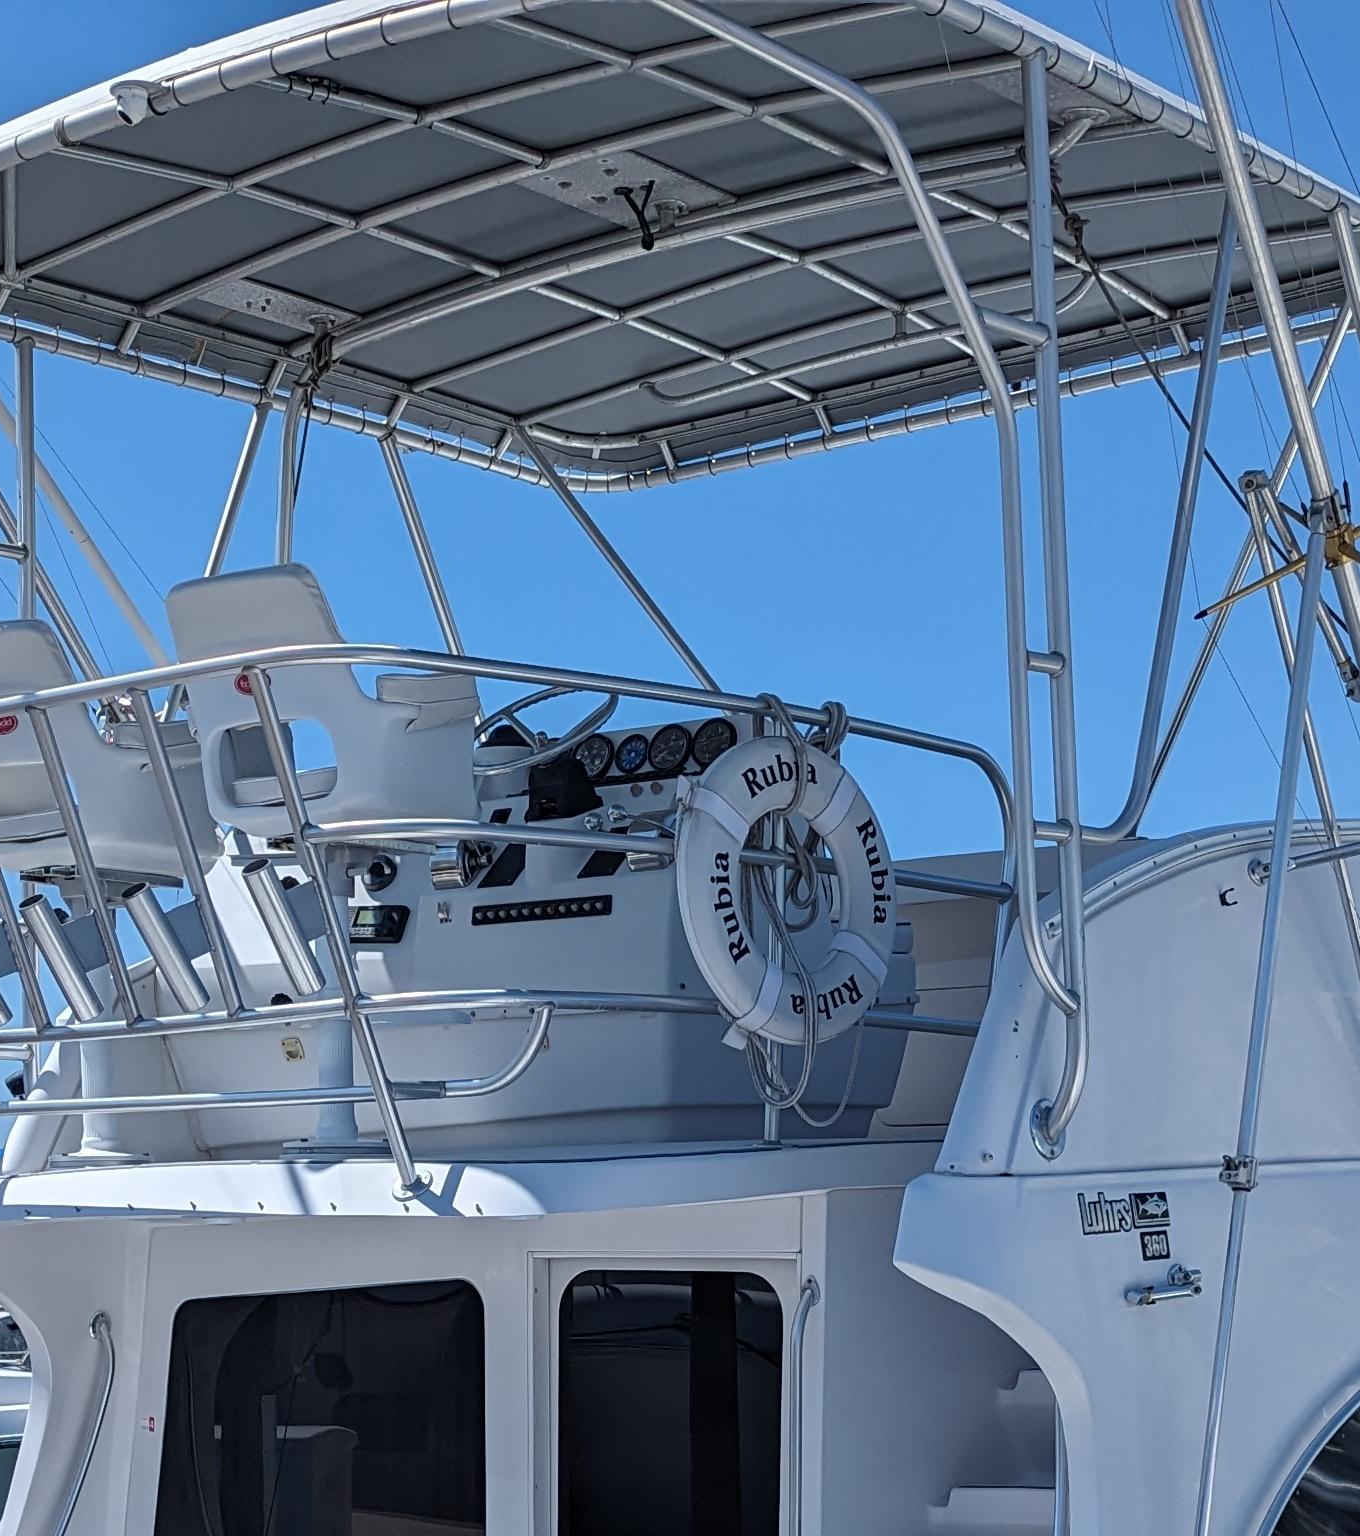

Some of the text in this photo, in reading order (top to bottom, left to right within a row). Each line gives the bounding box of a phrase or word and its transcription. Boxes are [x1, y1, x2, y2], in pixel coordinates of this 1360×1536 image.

[855, 816, 892, 926] Rubia
[710, 851, 751, 965] Rubia
[790, 974, 864, 1021] Ruba
[1077, 1192, 1133, 1235] Luhrs
[1143, 1234, 1168, 1257] 360
